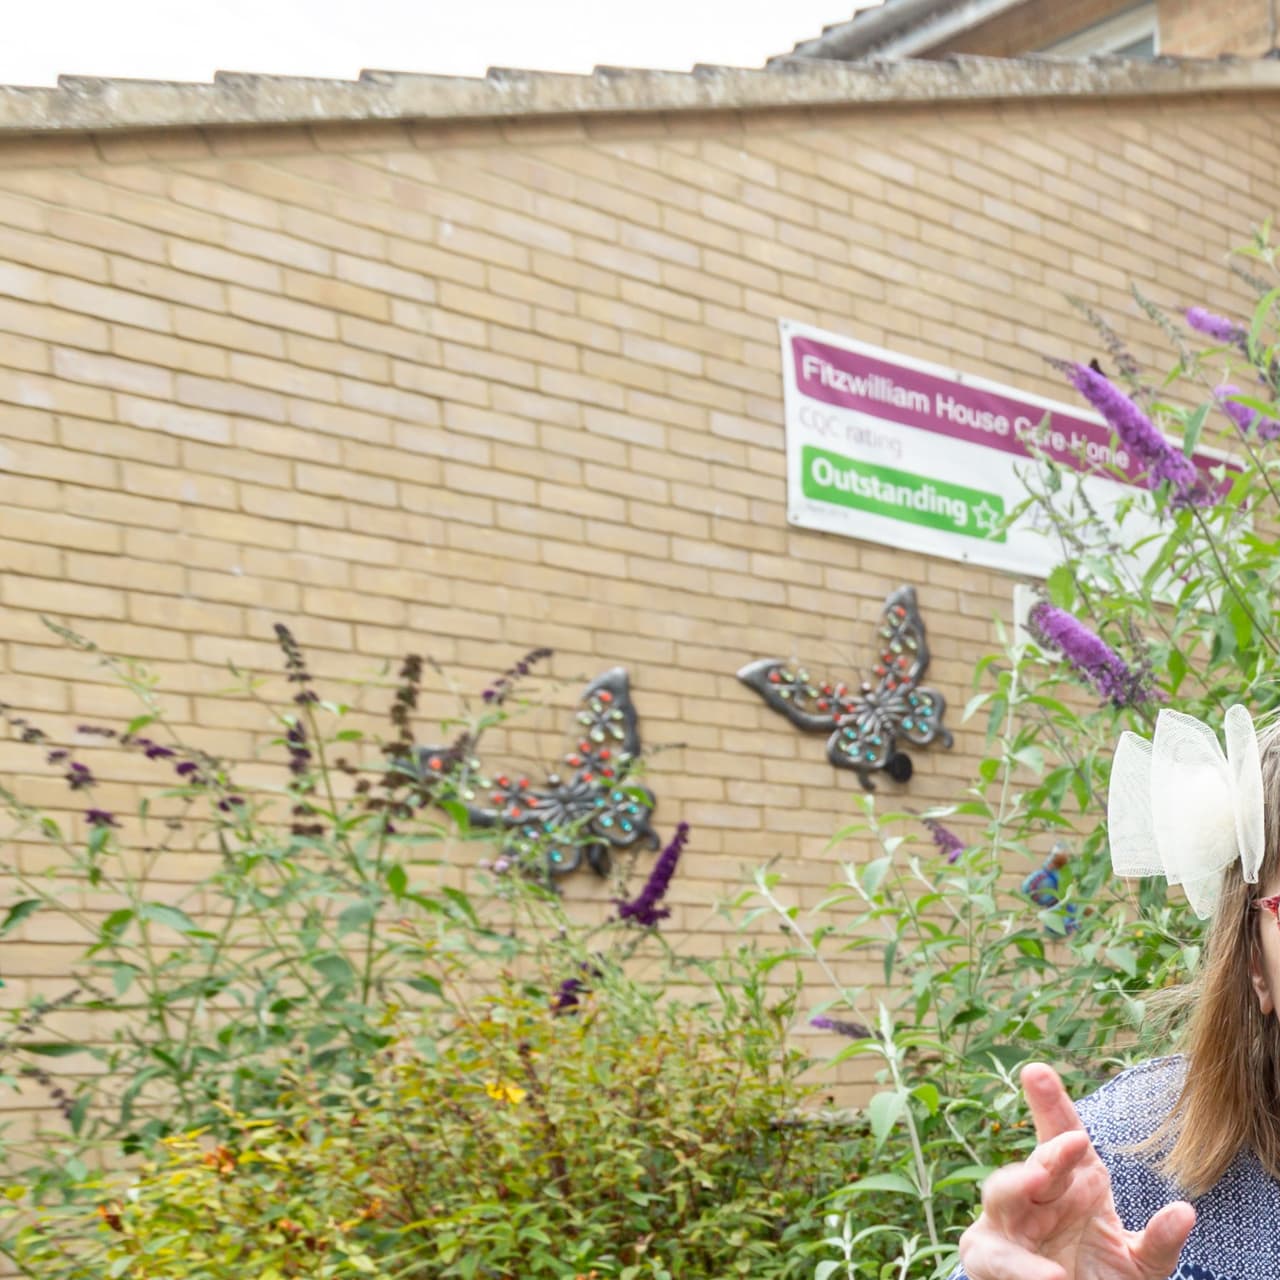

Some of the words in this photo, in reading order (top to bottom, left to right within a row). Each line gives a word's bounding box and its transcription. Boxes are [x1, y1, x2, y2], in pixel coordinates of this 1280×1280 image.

[802, 353, 930, 415] Fitzwilliam
[935, 392, 1009, 436] House
[799, 405, 840, 438] CQC
[845, 426, 903, 460] rating
[811, 456, 968, 527] Outstanding
